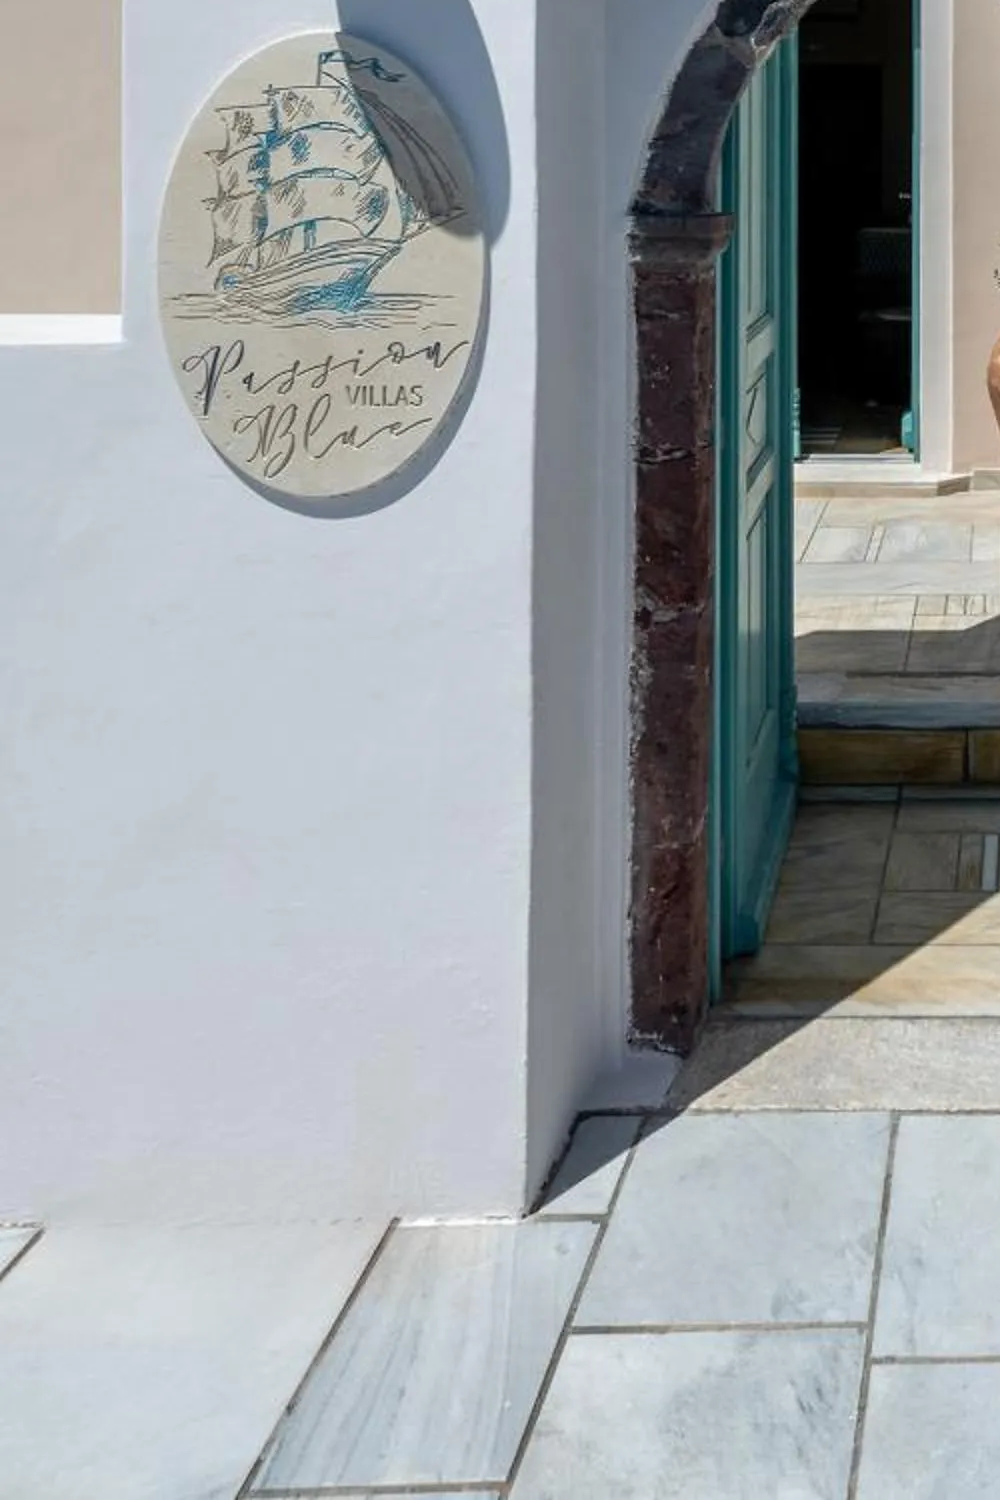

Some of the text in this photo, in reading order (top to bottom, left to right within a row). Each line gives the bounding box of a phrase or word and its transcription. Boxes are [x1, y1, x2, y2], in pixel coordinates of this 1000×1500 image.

[182, 339, 470, 417] Passion
[346, 385, 424, 407] VILLAS
[233, 393, 432, 478] Blue
